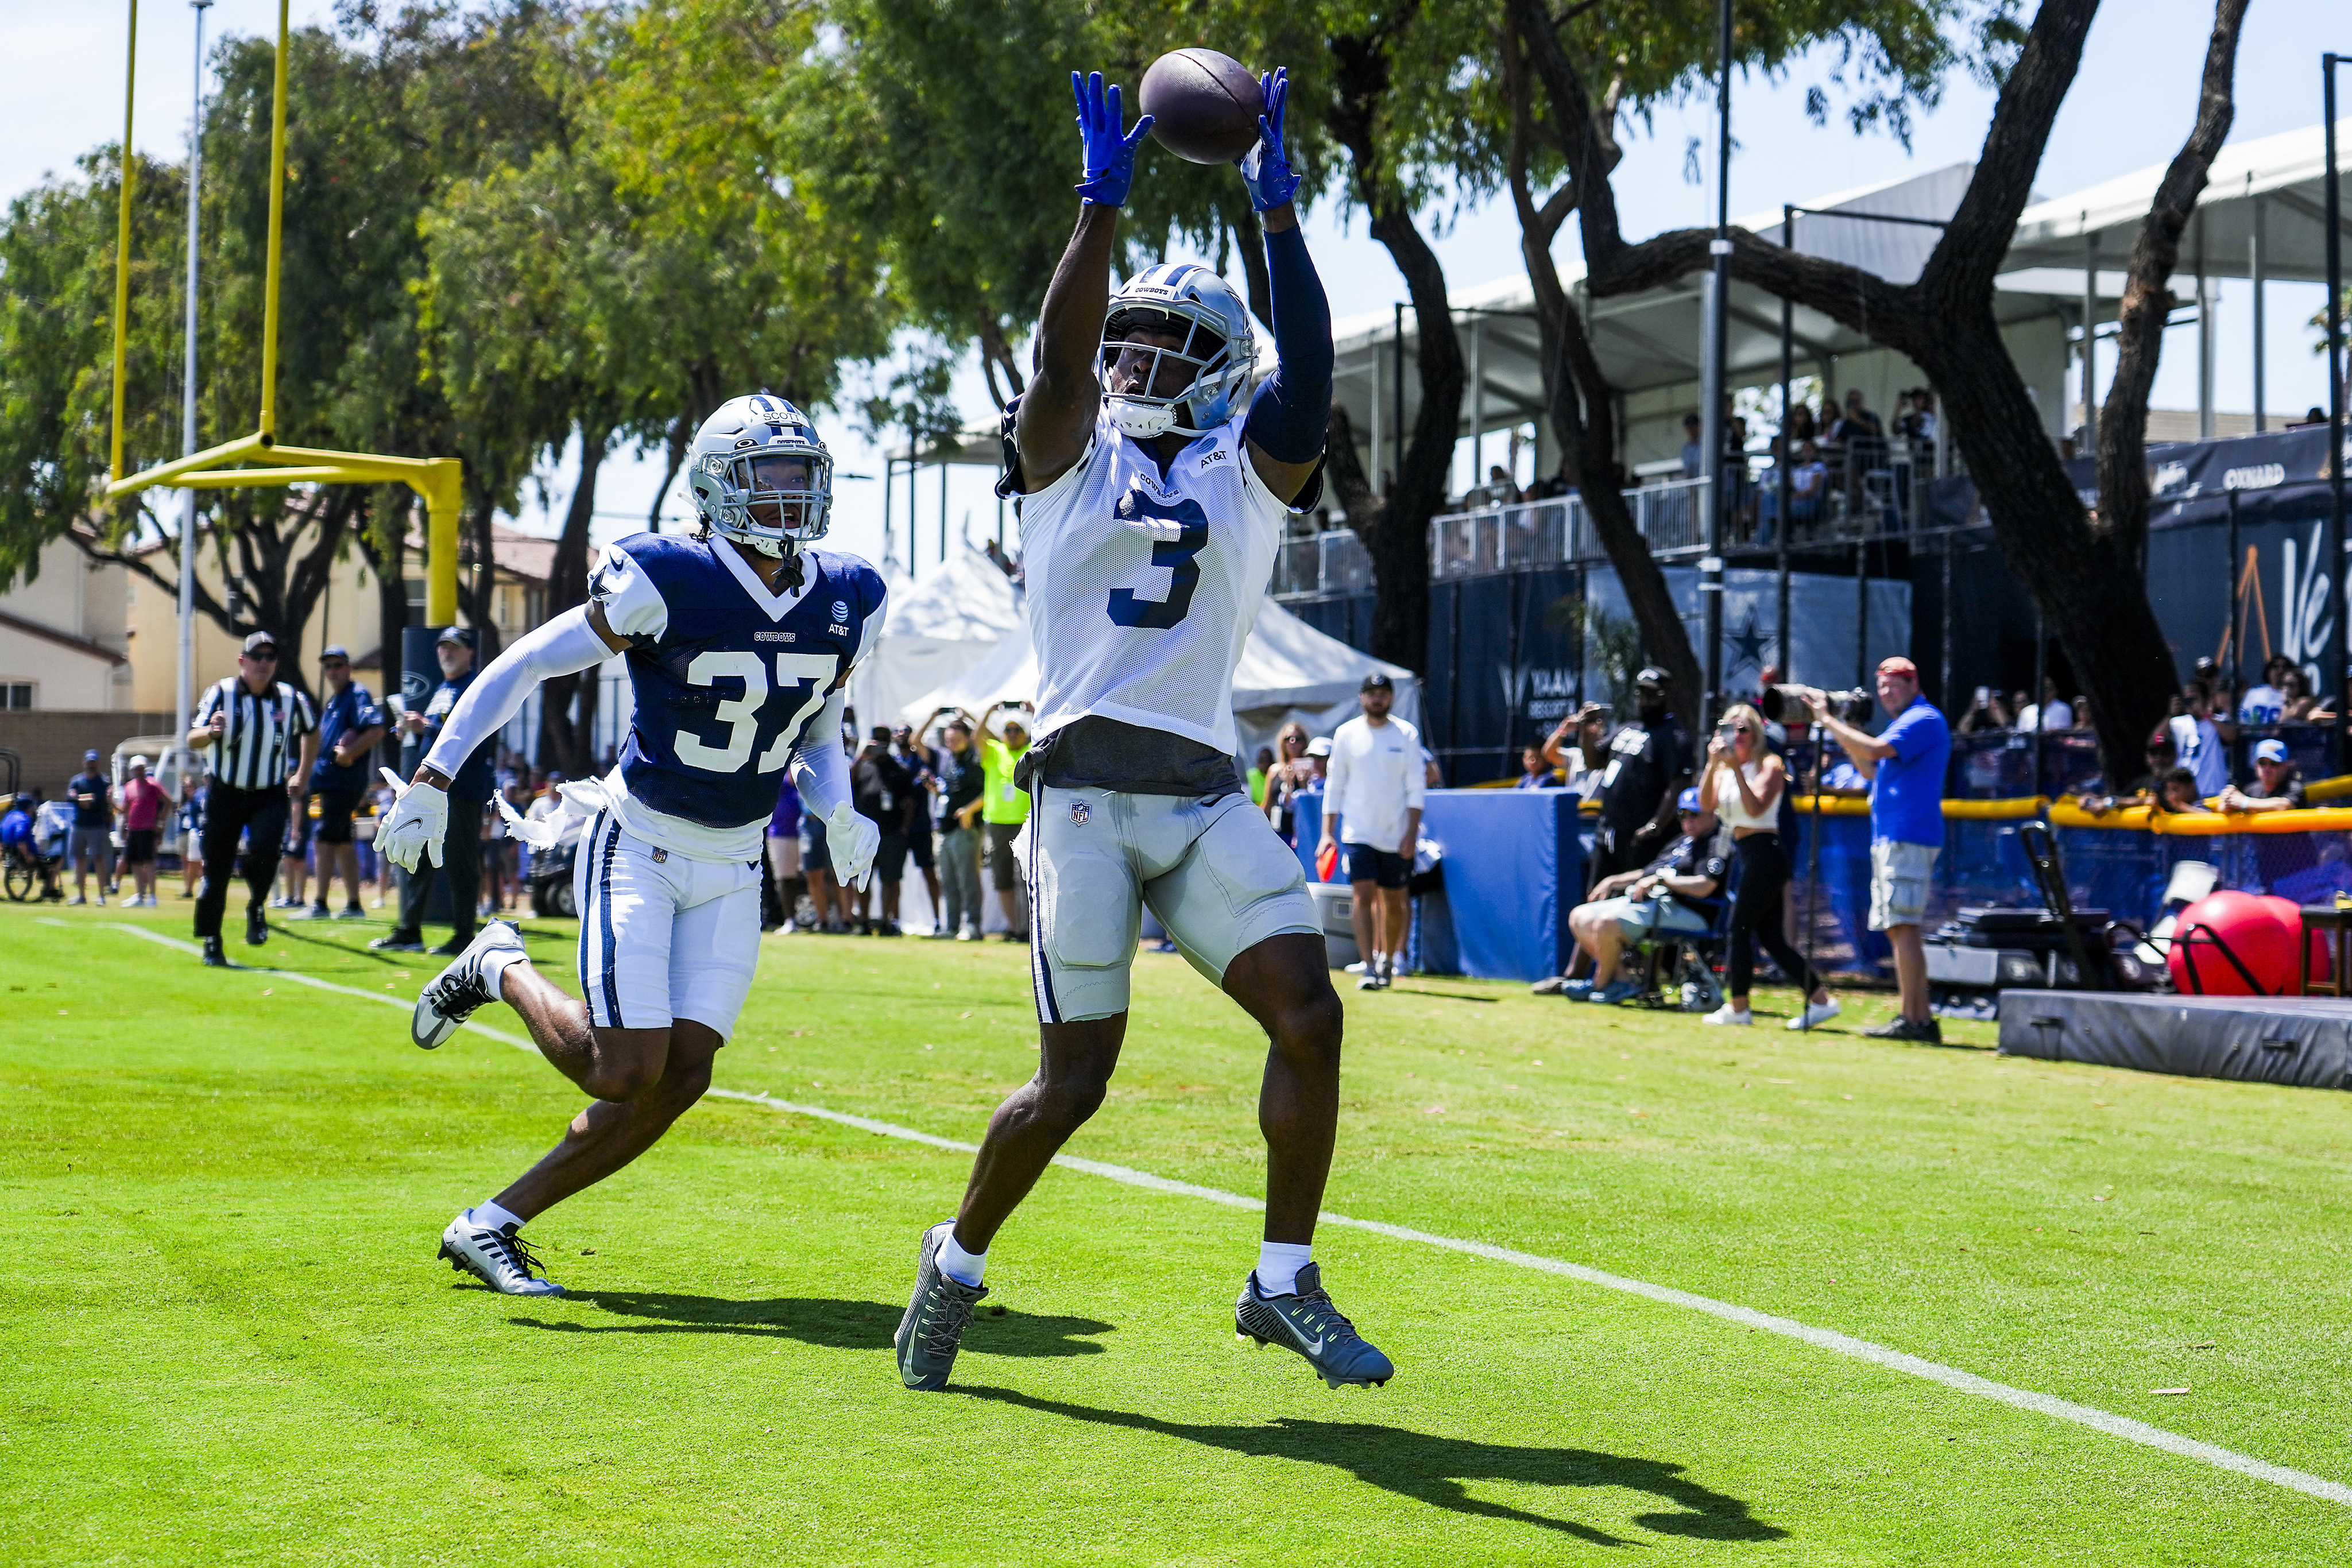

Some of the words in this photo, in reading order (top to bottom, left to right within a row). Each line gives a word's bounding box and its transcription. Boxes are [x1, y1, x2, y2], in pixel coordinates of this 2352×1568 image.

[1135, 287, 1169, 295] COWBOYS
[763, 412, 799, 421] SCOTT
[1200, 451, 1227, 469] AT&T
[2223, 463, 2285, 490] OXNARD
[1107, 489, 1209, 630] 3
[828, 624, 849, 637] AT&T
[754, 632, 796, 642] COWBOYS
[674, 651, 840, 775] 37
[1073, 811, 1088, 822] NFL
[653, 851, 665, 862] NFL
